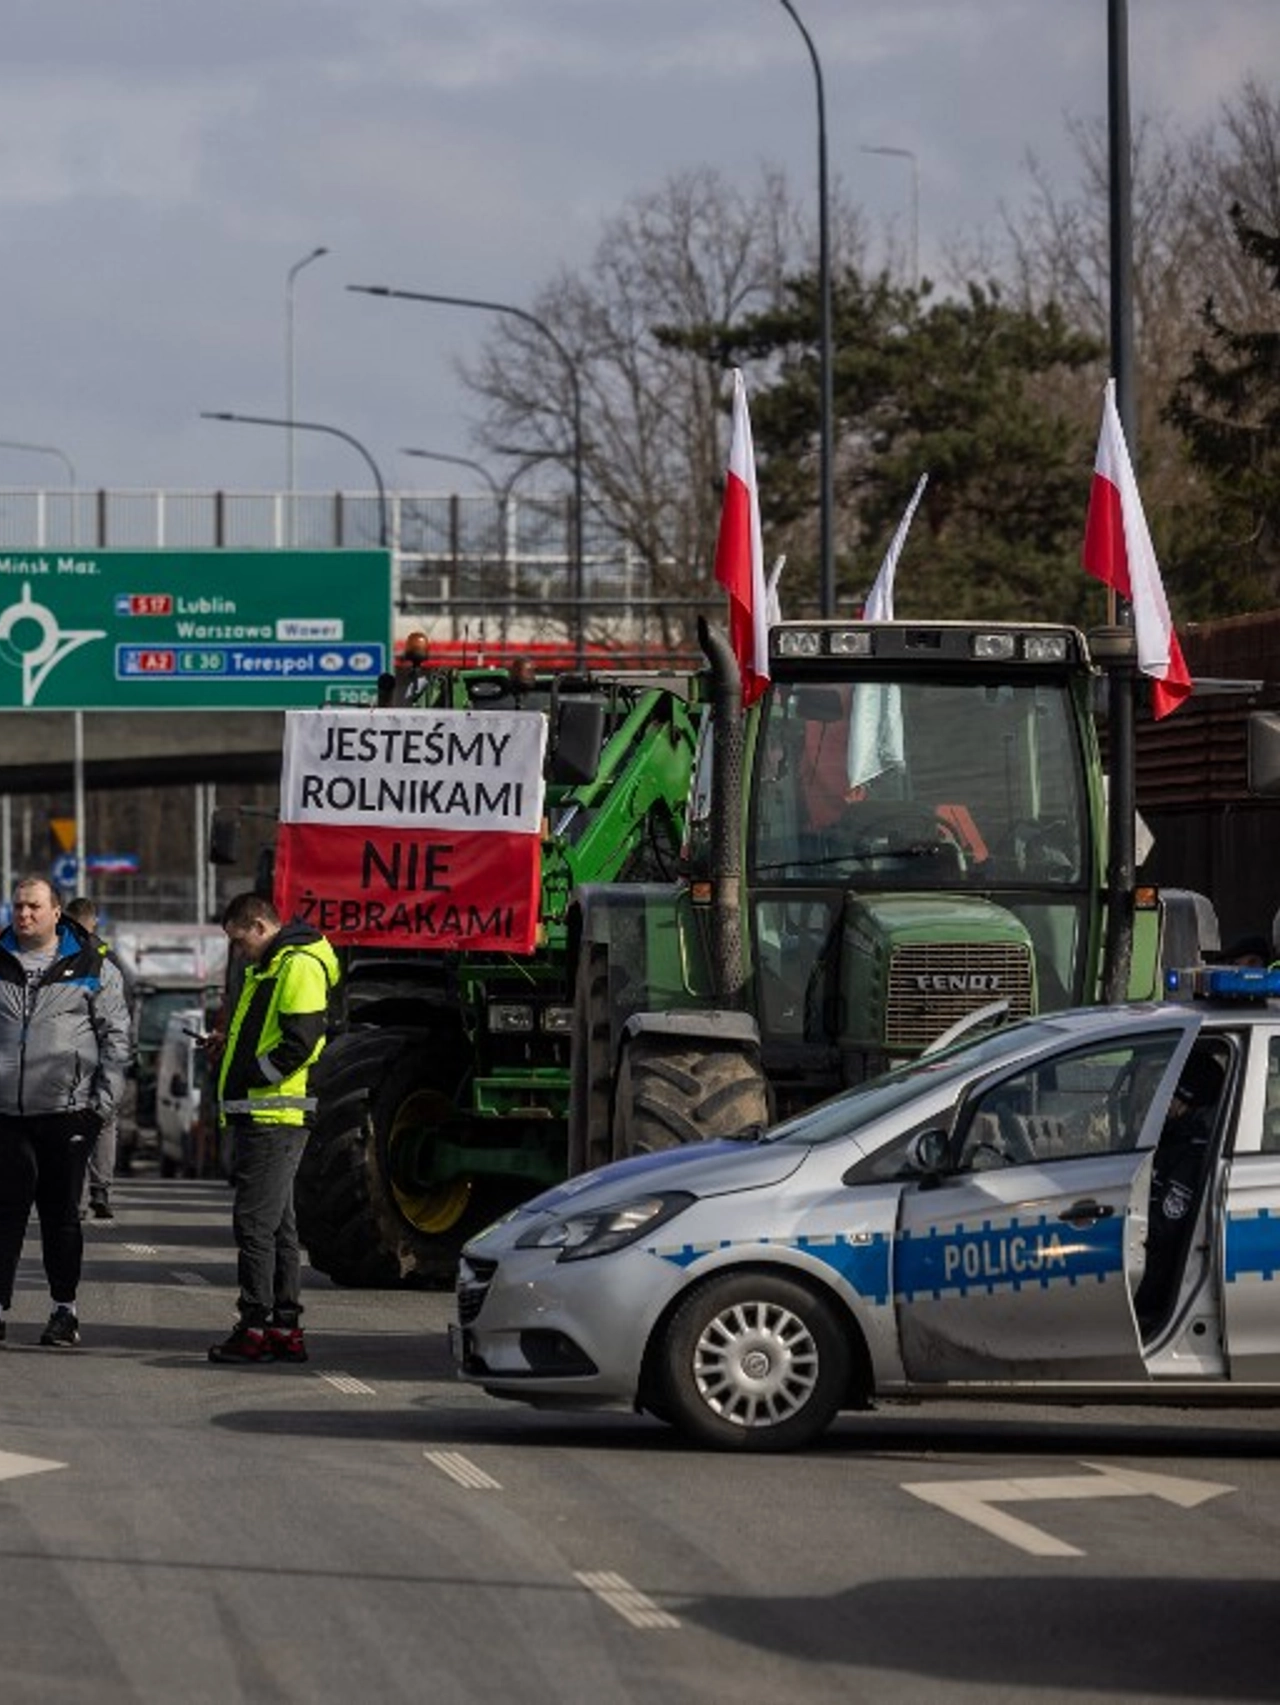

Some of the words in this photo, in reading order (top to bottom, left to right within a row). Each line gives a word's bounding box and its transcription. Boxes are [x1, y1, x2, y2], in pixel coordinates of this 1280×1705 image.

[58, 557, 101, 574] Maz.
[177, 596, 236, 614] Lublin
[176, 621, 272, 638] Warszawa
[283, 622, 337, 636] Wawer
[145, 653, 169, 669] A2
[184, 654, 193, 669] E
[200, 654, 221, 669] 30
[232, 653, 314, 675] Terespol
[319, 722, 511, 767] JESTEŚMY
[301, 775, 524, 817] ROLNIKAMI
[360, 840, 455, 892] NIE
[299, 890, 515, 939] ŻEBRAKAMI
[918, 974, 1000, 990] FENDT
[944, 1232, 1067, 1281] POLICJA
